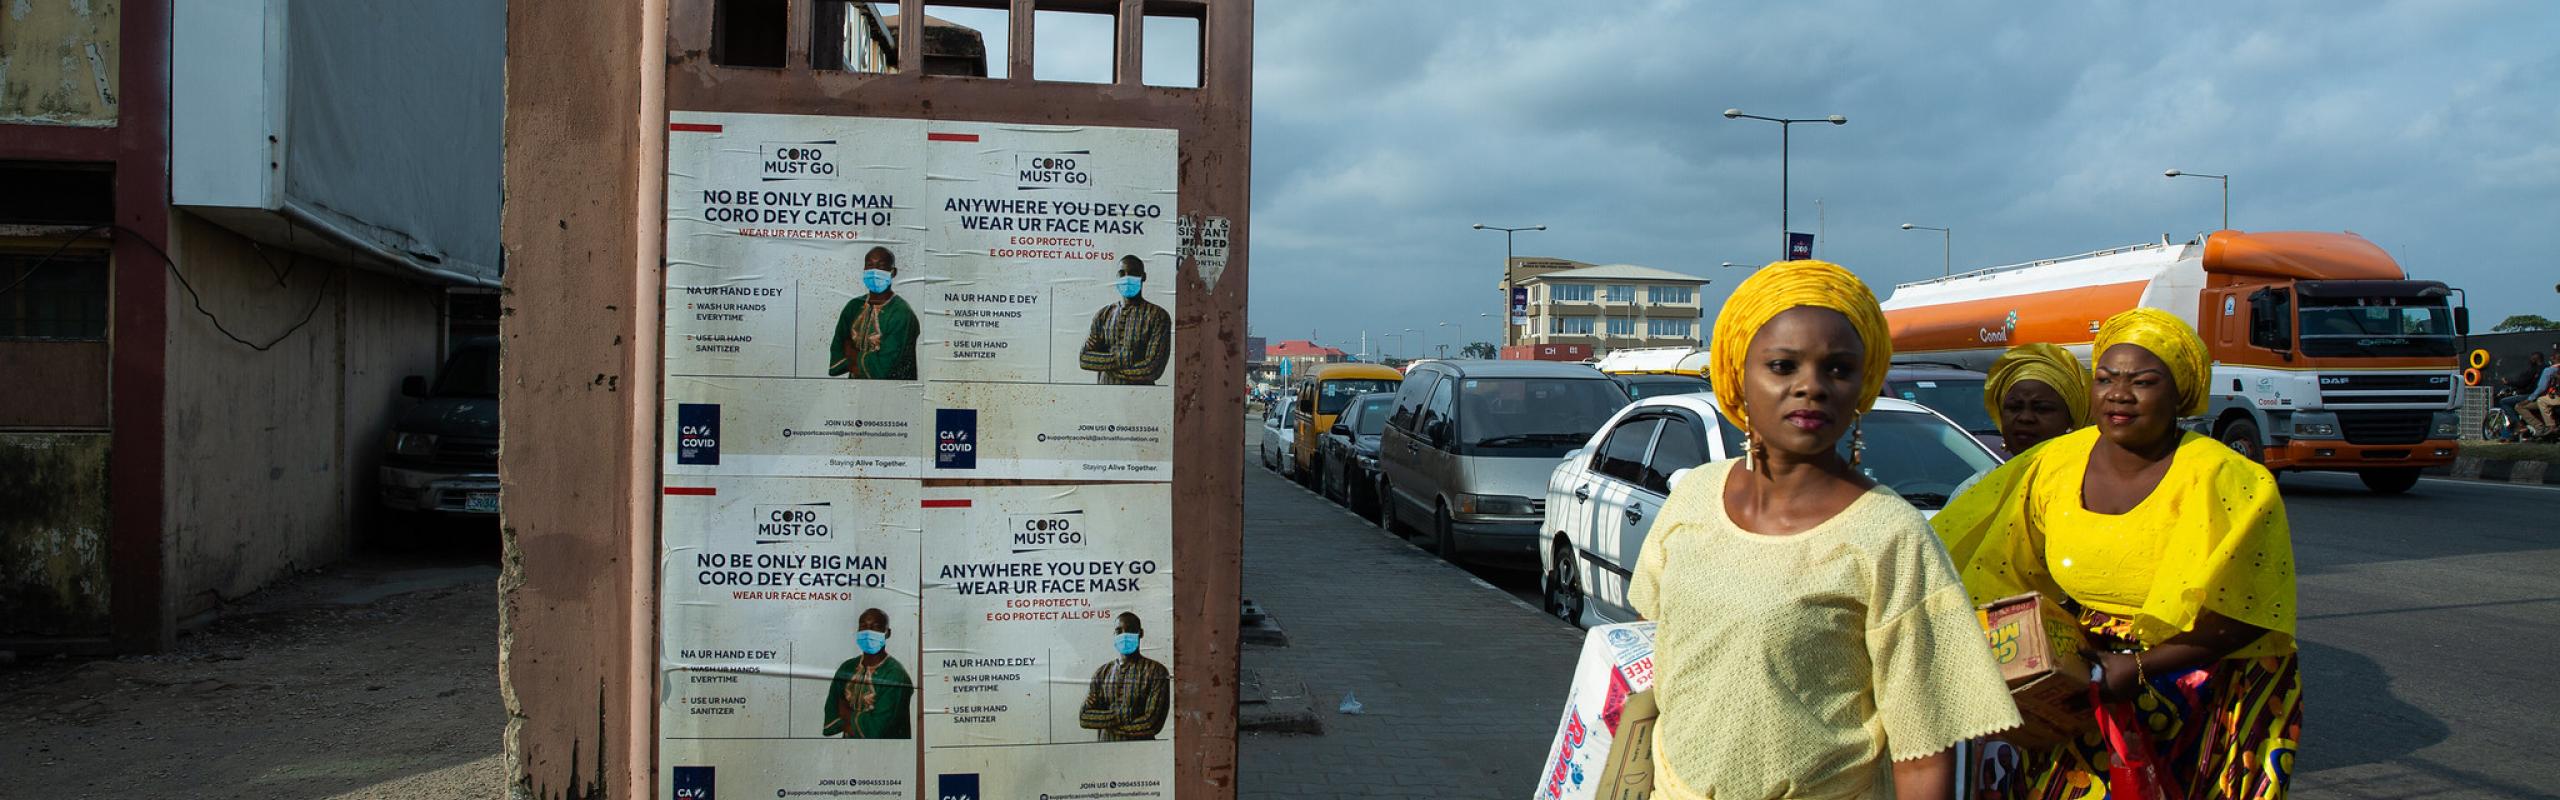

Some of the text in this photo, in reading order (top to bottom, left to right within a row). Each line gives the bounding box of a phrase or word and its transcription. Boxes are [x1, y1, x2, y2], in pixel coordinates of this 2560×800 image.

[777, 148, 821, 160] CORO
[764, 161, 833, 174] MUST GO
[1032, 158, 1075, 171] CORO
[1020, 170, 1087, 184] MUST GO
[704, 190, 893, 209] NO BE ONLY BIG MAN
[945, 198, 1160, 218] ANYWHERE YOU DEY GO
[704, 208, 891, 226] CORO DEY CATCH O!
[961, 215, 1144, 235] WEAR UR FACE MASK
[1220, 220, 1228, 228] &
[738, 228, 858, 240] WEAR UR FACE MASK O!
[1178, 227, 1228, 237] SISANT
[1010, 236, 1016, 245] E
[1019, 237, 1034, 245] GO
[1036, 237, 1083, 247] PROTECT
[990, 248, 1114, 260] E GO PROTECT ALL OF US
[686, 286, 783, 297] NA UR HAND E DEY
[945, 293, 1038, 304] NA UR HAND E DEY
[723, 303, 735, 311] UR
[736, 304, 766, 312] HANDS
[980, 310, 991, 318] UR
[954, 320, 999, 328] EVERYTIME
[696, 334, 713, 342] USE
[1980, 327, 2008, 342] Conoil
[696, 345, 740, 353] SANITIZER
[971, 341, 982, 349] UR
[984, 341, 1008, 349] HAND
[953, 351, 996, 359] SANITIZER
[682, 426, 697, 435] CA
[940, 431, 954, 439] CA
[682, 438, 715, 447] COVID
[940, 443, 972, 451] COVID
[1083, 464, 1106, 472] Staying
[771, 510, 816, 522] CORO
[758, 524, 828, 536] MUST GO
[1025, 519, 1069, 531] CORO
[1014, 532, 1081, 545] MUST GO
[698, 553, 887, 570] NO BE ONLY BIG MAN
[940, 560, 1156, 579] ANYWHERE YOU DEY GO
[698, 571, 885, 588] CORO DEY CATCH O!
[957, 578, 1140, 595] WEAR UR FACE MASK
[733, 591, 852, 601] WEAR UR FACE MASK O!
[1007, 599, 1091, 608] E GO PROTECT U,
[987, 610, 1111, 621] E GO PROTECT ALL OF US
[681, 650, 777, 659] NA UR HAND E DEY
[943, 657, 1035, 668] NA UR HAND E DEY
[1625, 657, 1655, 679] REE
[953, 685, 998, 693] EVERYTIME
[690, 697, 707, 705] USE
[690, 707, 734, 715] SANITIZER
[971, 705, 982, 713] UR
[953, 715, 996, 723] SANITIZER
